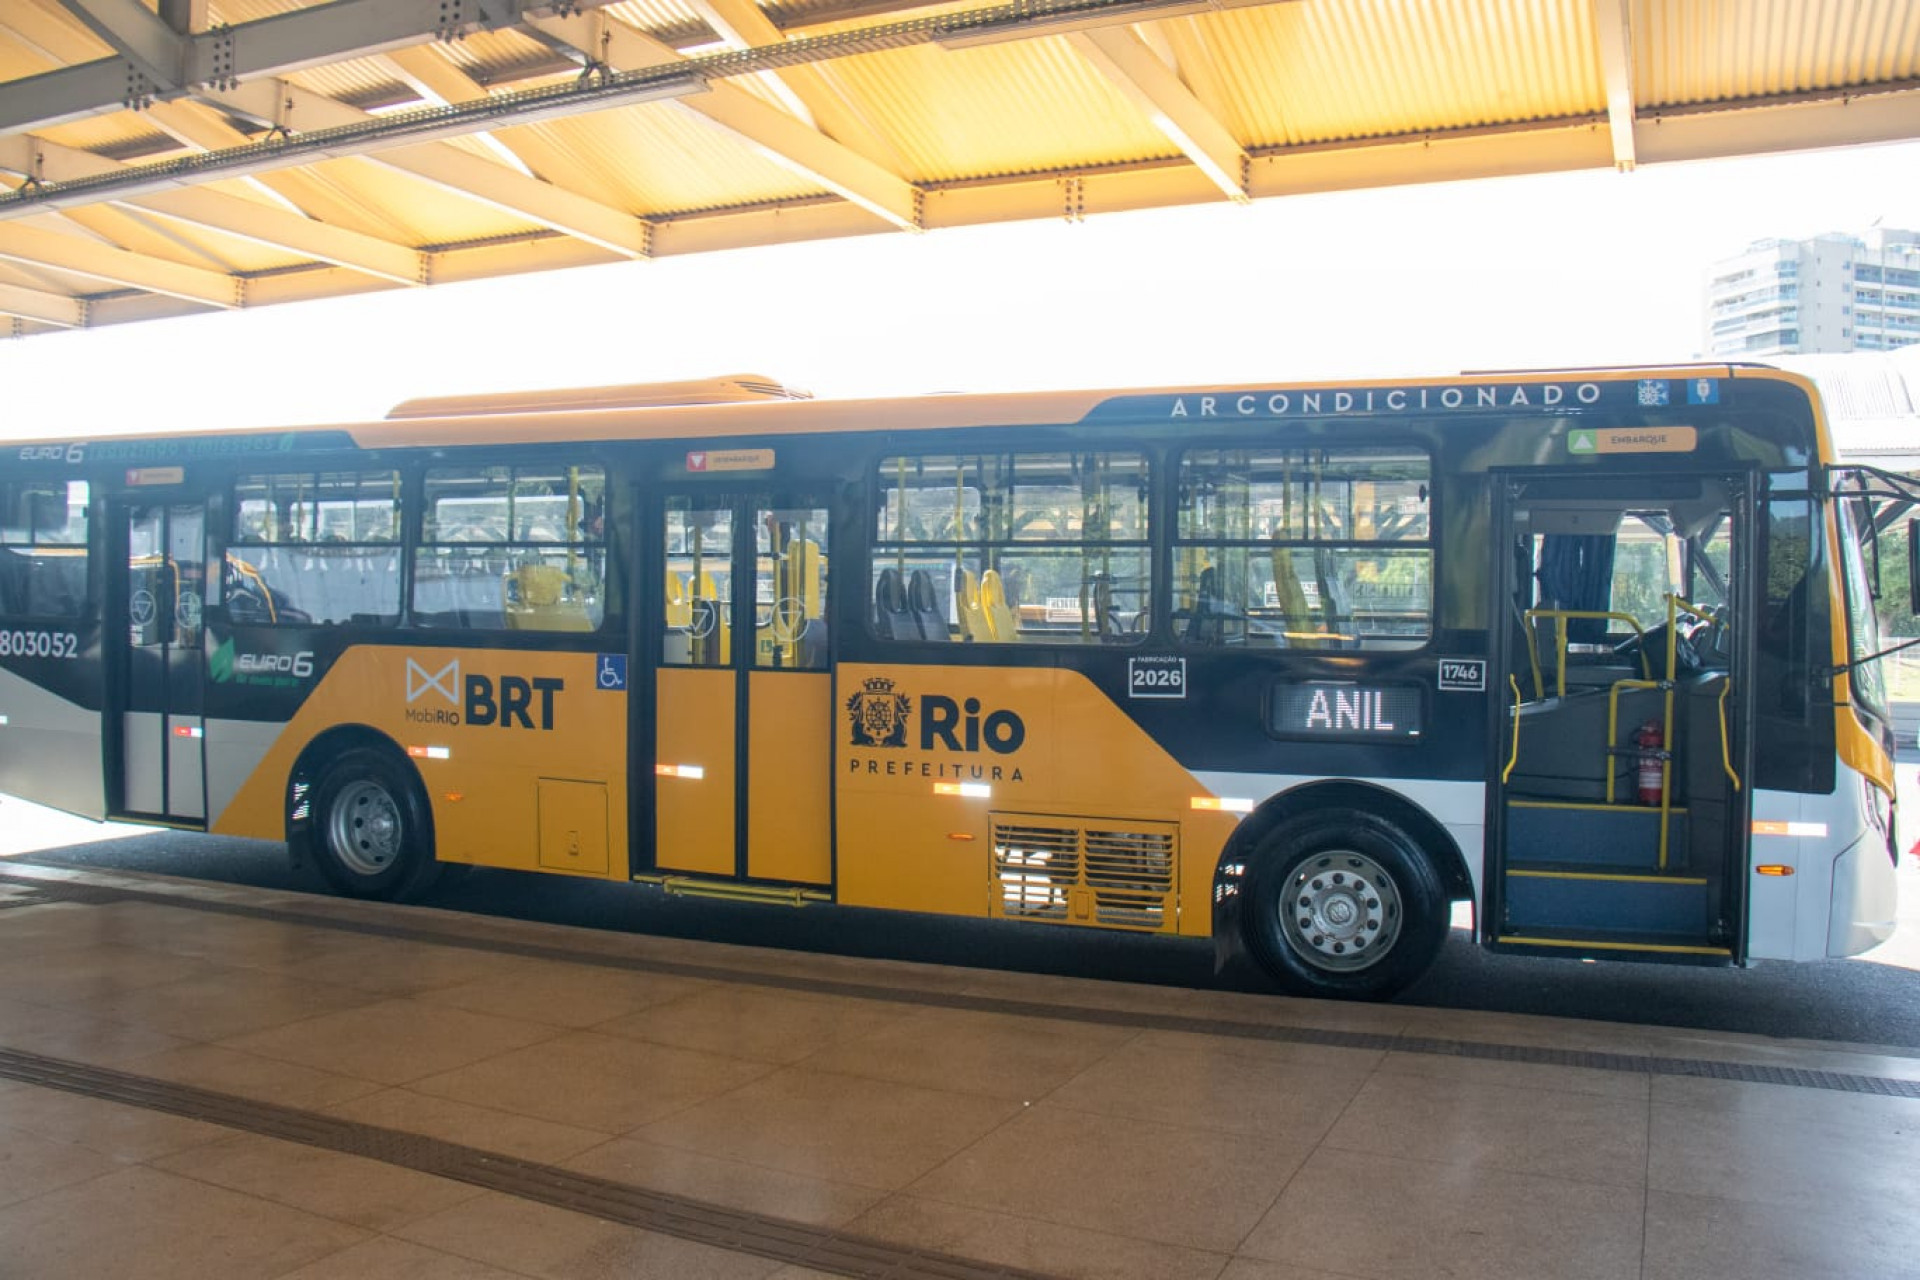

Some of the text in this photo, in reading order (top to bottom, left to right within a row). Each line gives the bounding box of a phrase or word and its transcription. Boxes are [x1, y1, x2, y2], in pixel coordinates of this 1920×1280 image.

[1171, 383, 1600, 417] AR CONDICIONADO
[0, 629, 78, 658] 803052
[1133, 670, 1182, 686] 2026
[1443, 664, 1478, 680] 1746
[465, 674, 564, 731] BRT
[1306, 690, 1393, 730] ANIL
[920, 694, 1025, 755] Rio
[850, 759, 1023, 782] PREFEITURA
